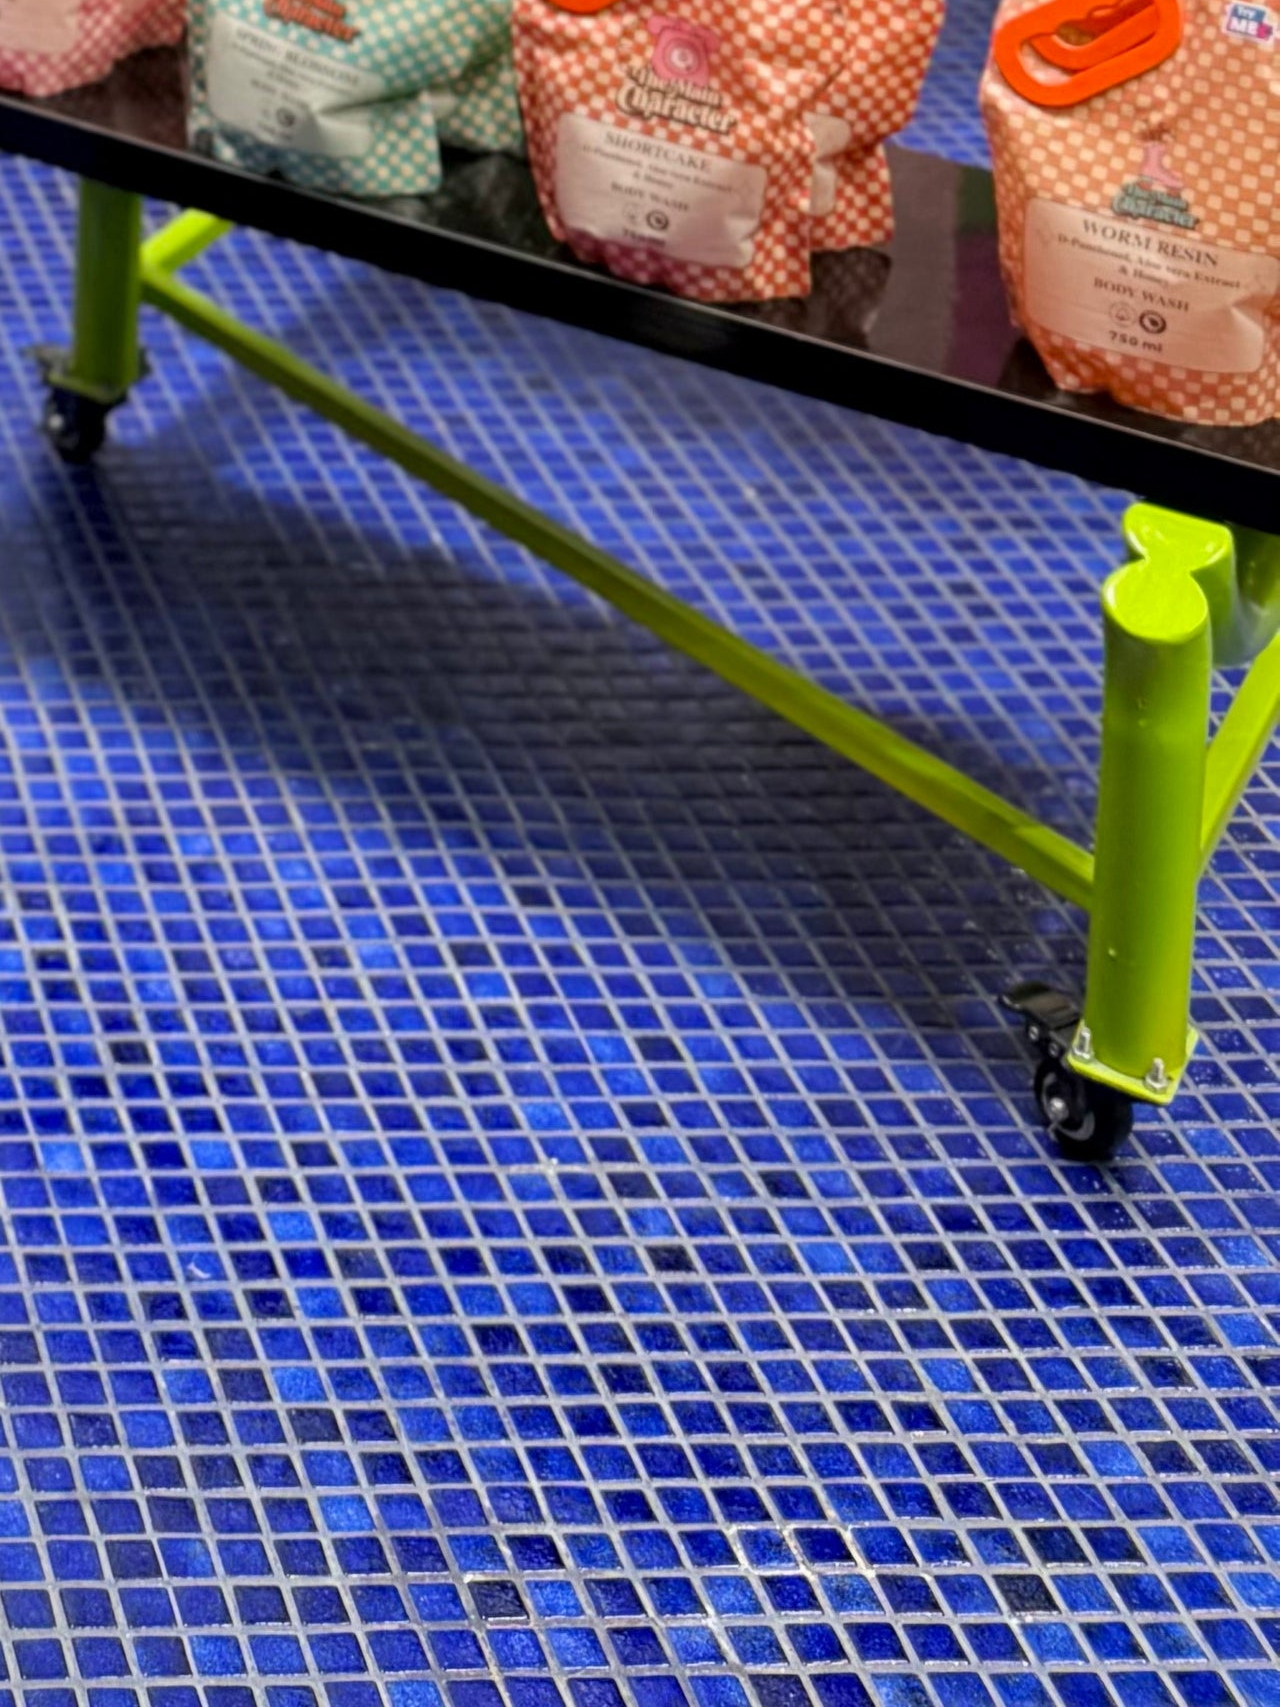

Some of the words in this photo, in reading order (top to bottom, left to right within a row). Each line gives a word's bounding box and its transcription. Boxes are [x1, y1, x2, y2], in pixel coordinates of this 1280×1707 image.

[1230, 17, 1258, 36] ME
[616, 84, 737, 136] Character
[605, 131, 710, 171] SHORTCAKE
[1083, 218, 1151, 249] WORM
[1157, 240, 1219, 267] RESIN
[1093, 277, 1138, 298] BODY
[1142, 290, 1189, 312] WASH
[1108, 330, 1139, 347] 750
